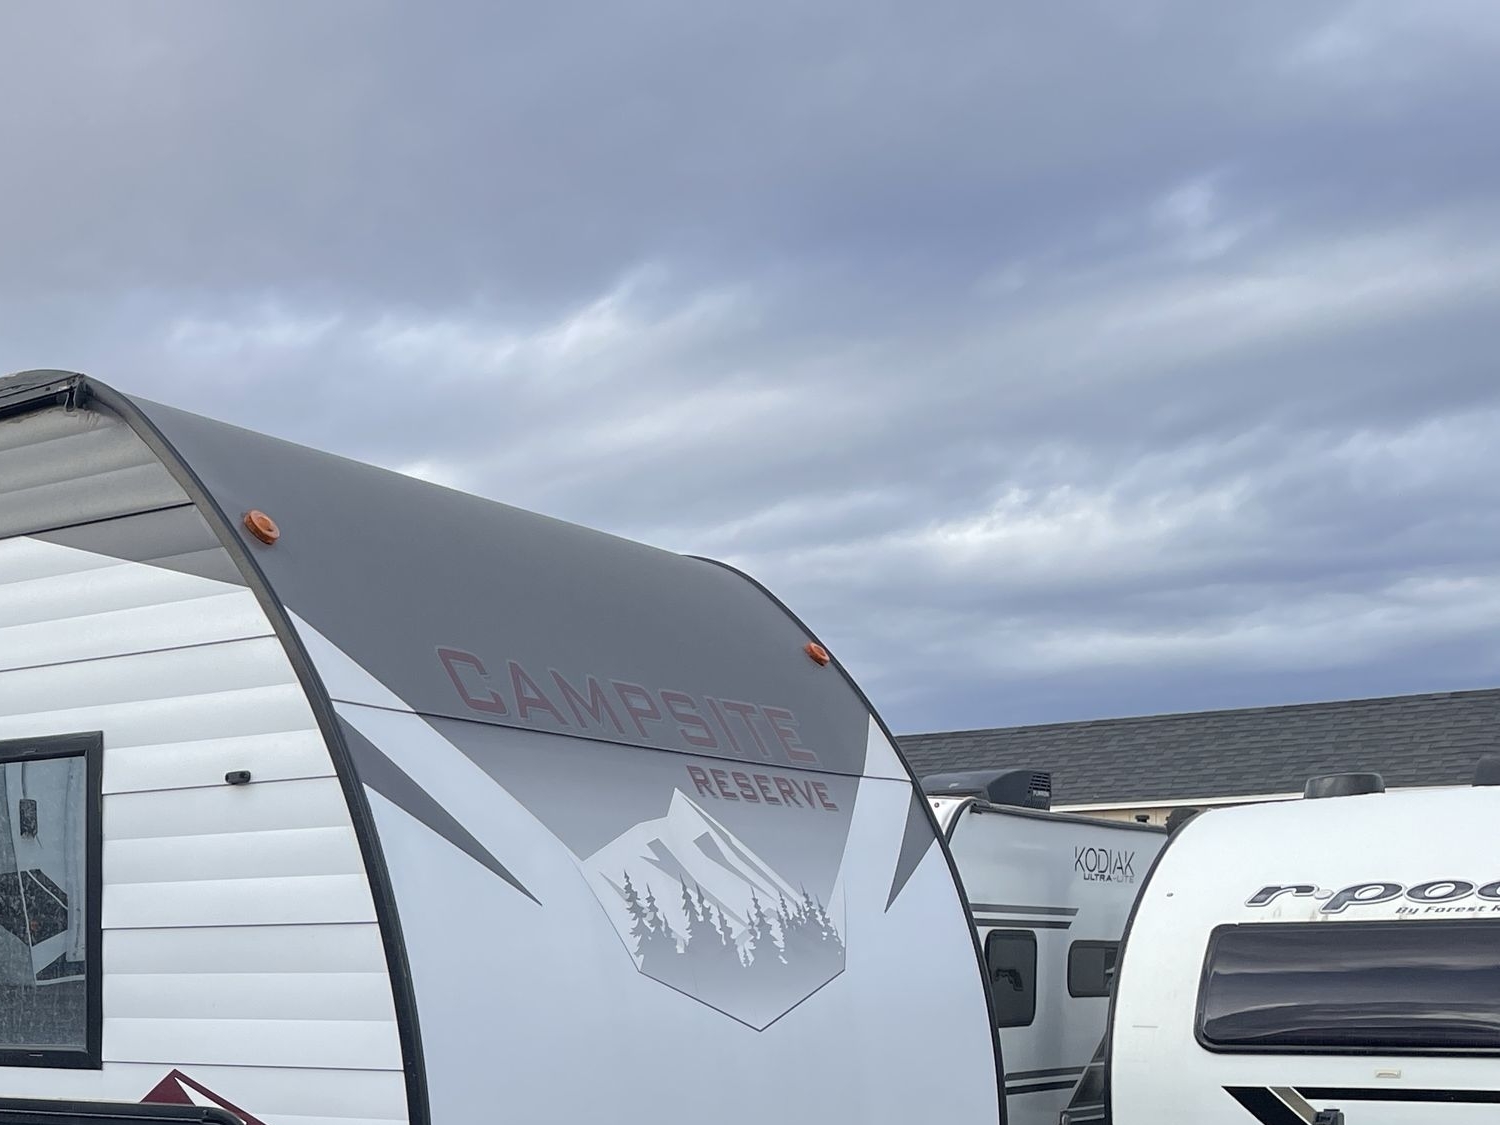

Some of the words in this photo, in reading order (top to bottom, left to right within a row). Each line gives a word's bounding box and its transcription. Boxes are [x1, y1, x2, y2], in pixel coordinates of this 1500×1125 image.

[436, 646, 818, 764] CAMPSITE
[686, 765, 838, 811] RESERVE
[1074, 845, 1135, 876] KODIAK
[1424, 904, 1487, 914] Forest
